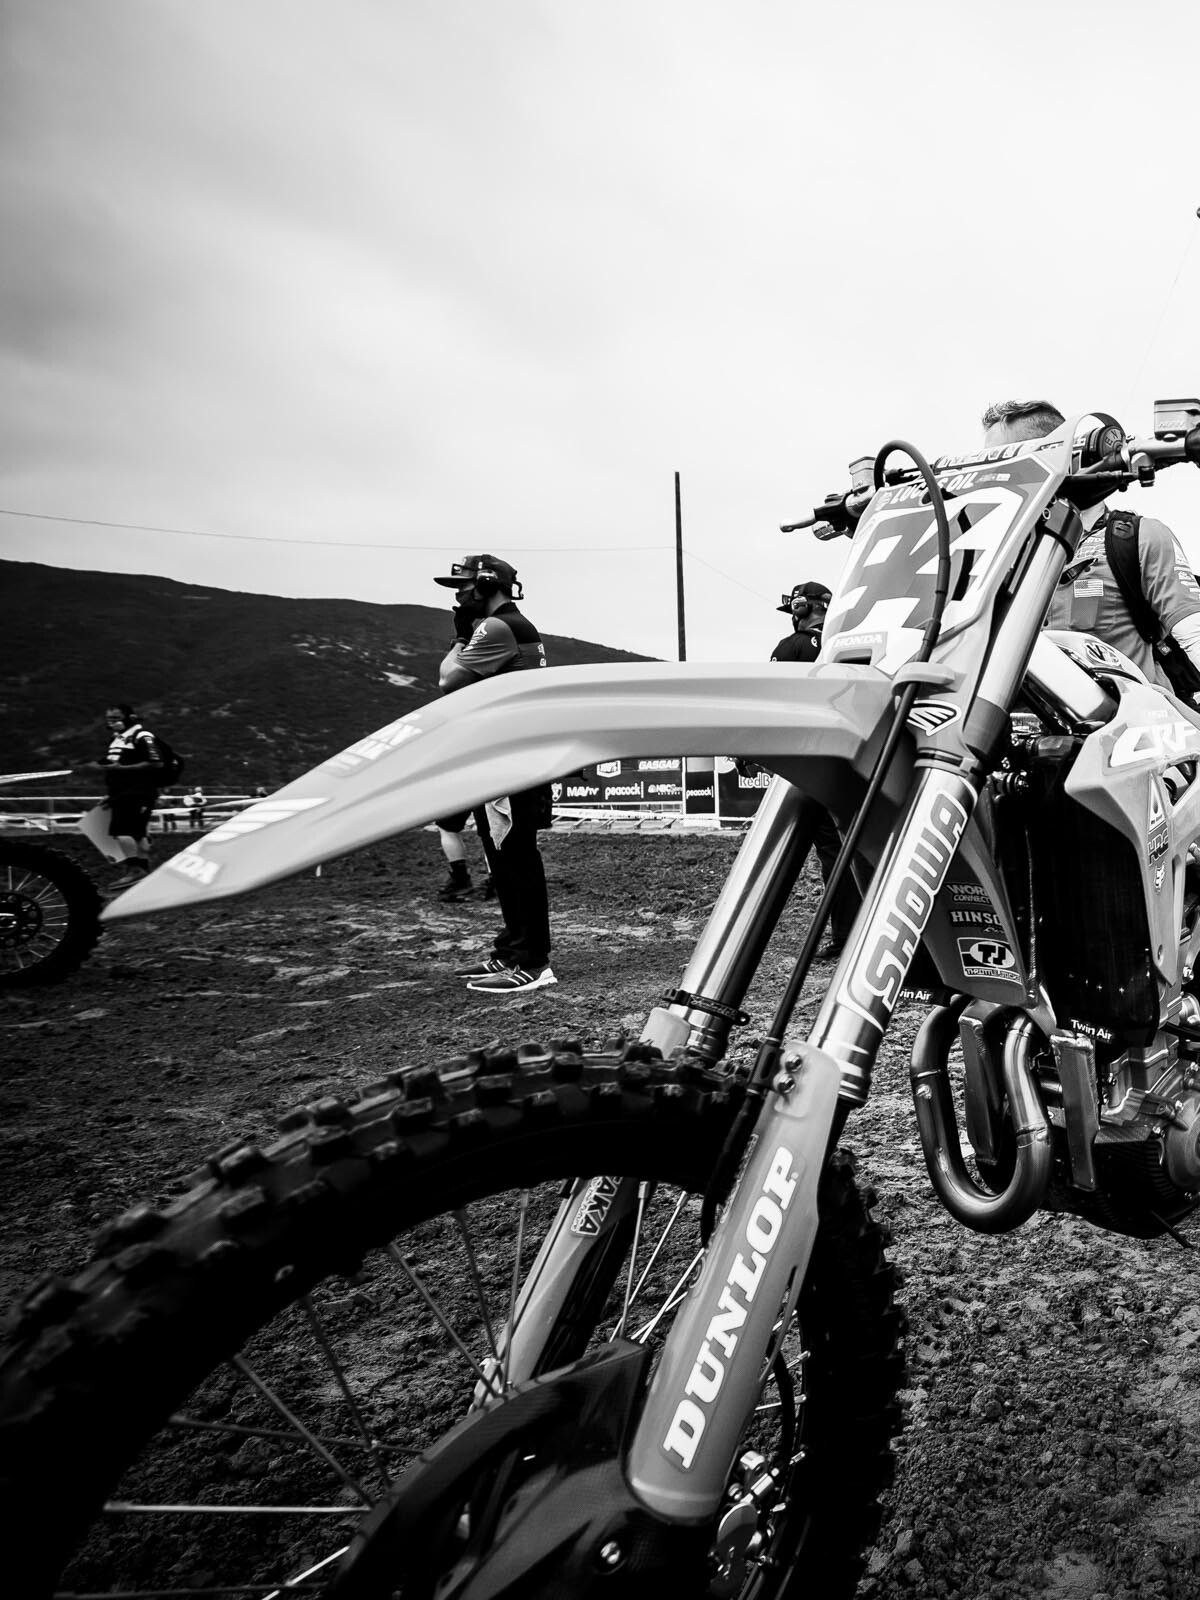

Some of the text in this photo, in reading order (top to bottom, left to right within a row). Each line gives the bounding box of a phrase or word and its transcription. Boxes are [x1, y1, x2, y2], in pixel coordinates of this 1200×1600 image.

[638, 759, 679, 769] GASGAS
[605, 782, 640, 800] peacock
[686, 786, 711, 799] peacock
[865, 794, 967, 1008] SHOWA
[915, 990, 932, 1001] Air
[1071, 1019, 1112, 1040] Twin Air
[577, 1176, 621, 1235] AKA
[662, 1146, 797, 1470] DUNLOP
